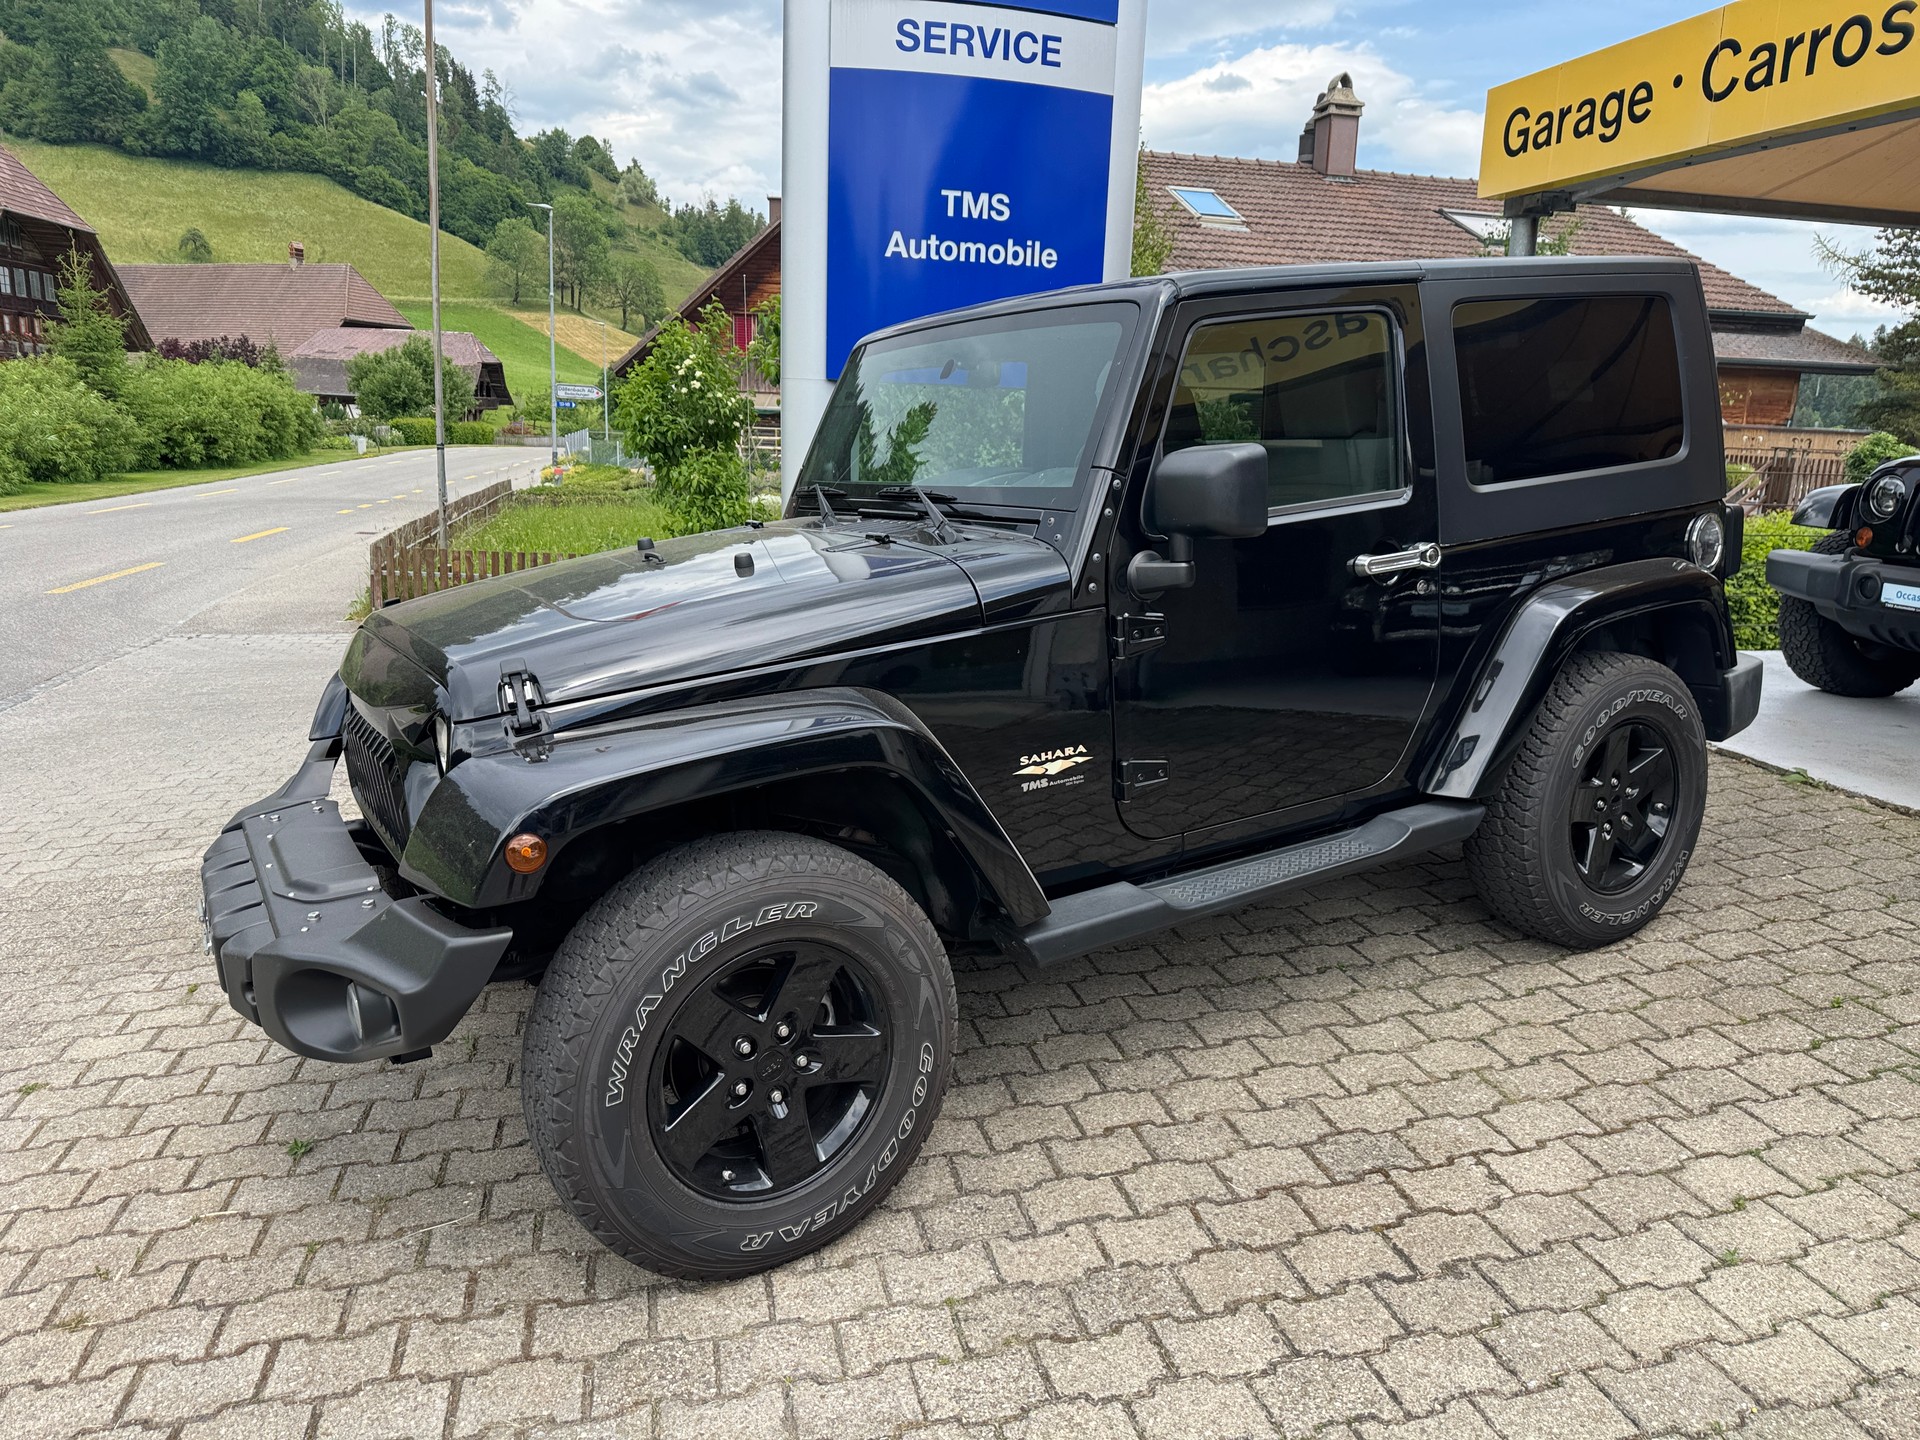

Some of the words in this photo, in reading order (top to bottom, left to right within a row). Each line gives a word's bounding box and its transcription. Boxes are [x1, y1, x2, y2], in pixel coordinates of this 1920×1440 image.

[895, 17, 1063, 68] SERVICE
[1503, 80, 1654, 158] Garage
[1701, 0, 1919, 103] Carros
[940, 189, 1011, 222] TMS
[884, 230, 1059, 269] Automobile
[1019, 744, 1088, 766] SAHARA
[1572, 689, 1688, 769] GOODYEAR
[1020, 778, 1049, 792] TMS
[1049, 775, 1084, 786] Automobile
[1578, 850, 1689, 926] WRANGLER
[606, 901, 818, 1107] WRANGLER
[740, 1042, 934, 1251] GOODYEAR
